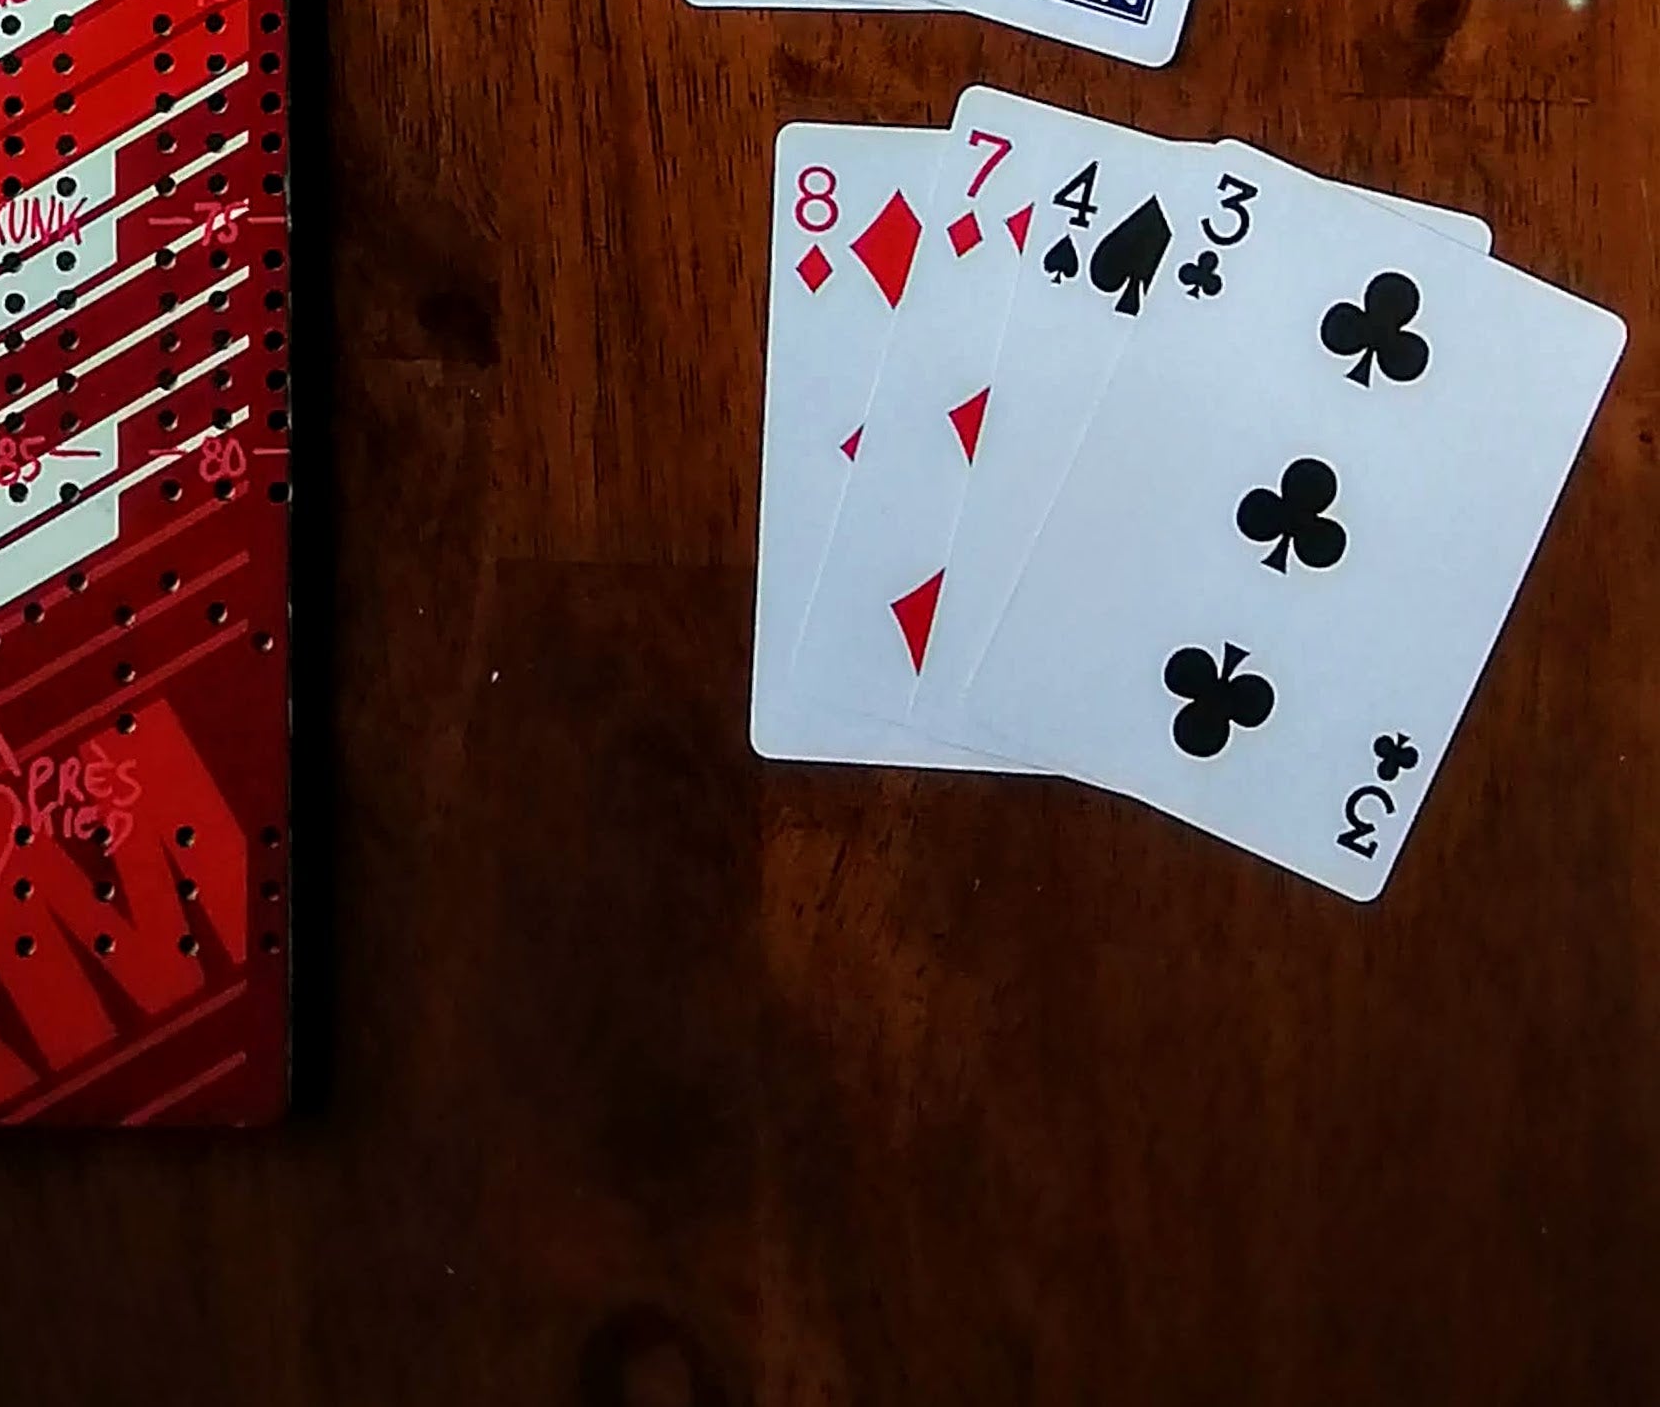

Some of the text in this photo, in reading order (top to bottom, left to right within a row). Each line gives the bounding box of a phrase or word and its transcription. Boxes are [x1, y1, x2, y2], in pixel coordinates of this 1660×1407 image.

[964, 130, 1013, 199] 7
[1052, 160, 1099, 228] 4
[795, 166, 839, 232] 8
[1201, 172, 1259, 246] 3
[198, 439, 247, 481] 80
[1335, 784, 1394, 861] 3
